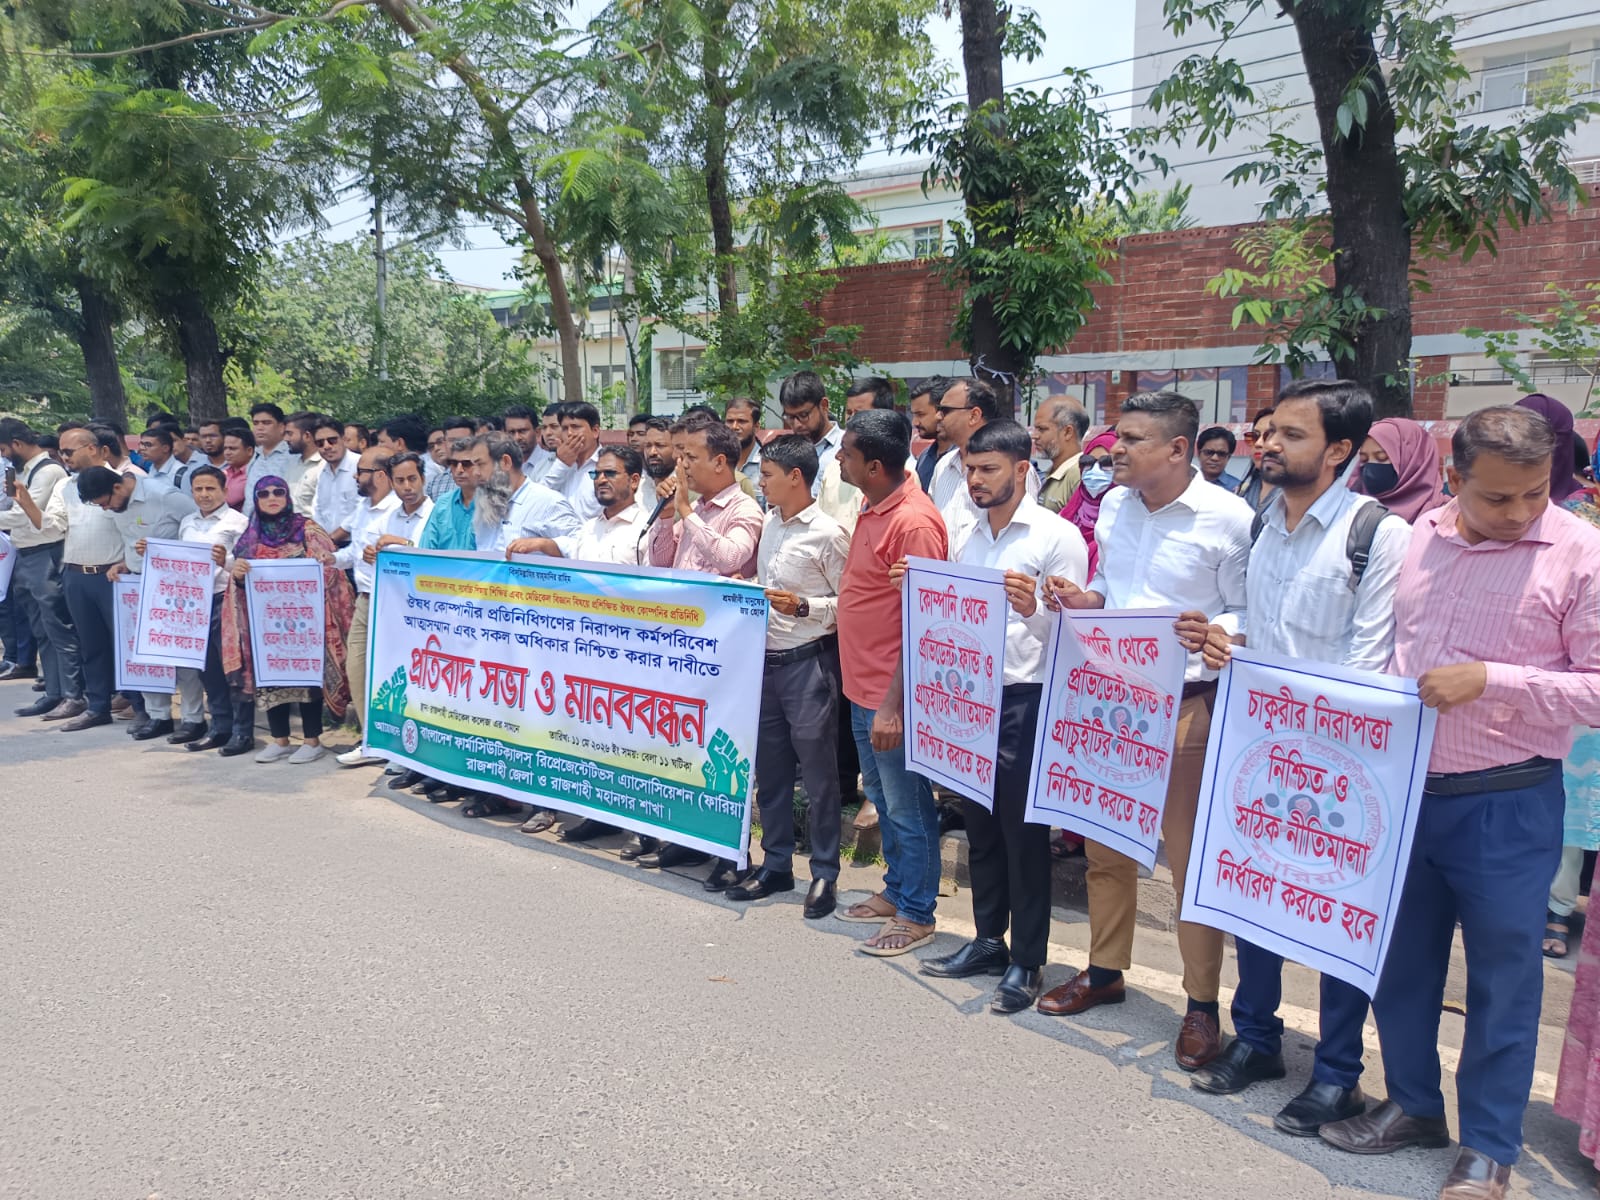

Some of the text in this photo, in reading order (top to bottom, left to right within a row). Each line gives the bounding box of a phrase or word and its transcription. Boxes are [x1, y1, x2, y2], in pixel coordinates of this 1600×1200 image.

[406, 593, 719, 655] ঔষধ কোম্পানীর প্রতিনিধিগণের নিরাপদ কর্মপরিবেশ
[509, 590, 523, 600] এবং
[918, 584, 989, 627] কোম্পানি থেকে
[404, 615, 723, 677] আত্মসম্মান এবং সকল অধিকার নিশ্চিত করার দাবীতে
[918, 628, 957, 668] প্রভিডেন্ট
[958, 645, 982, 676] ফান্ড
[984, 654, 994, 680] ও
[1118, 635, 1160, 667] থেকে
[409, 633, 708, 748] প্রতিবাদ সভা ও মানববন্ধন
[915, 680, 951, 721] গ্রাচুইটির
[952, 686, 996, 736] নীতিমালা
[1067, 660, 1127, 704] প্রভিডেন্ট
[1128, 684, 1163, 716] ফান্ড
[1163, 694, 1175, 720] ও
[1248, 685, 1393, 753] চাকুরীর নিরাপত্তা
[419, 726, 452, 747] বাংলাদেশ
[471, 715, 492, 727] কলেজ
[1051, 718, 1113, 761] গ্রাচুইটির
[1115, 726, 1169, 783] নীতিমালা
[571, 735, 580, 746] ১১
[581, 738, 590, 748] মে
[641, 752, 658, 765] বেলা
[659, 755, 669, 766] ১১
[670, 757, 693, 772] ঘটিকা
[916, 722, 944, 763] নিশ্চিত
[946, 741, 973, 774] করতে
[975, 753, 994, 785] হবে
[1267, 744, 1328, 794] নিশ্চিত
[1333, 774, 1349, 803] ও
[465, 757, 507, 780] রাজশাহী
[508, 769, 534, 786] জেলা
[537, 775, 547, 787] ও
[550, 776, 593, 801] রাজশাহী
[595, 787, 637, 811] মহানগর
[1046, 762, 1160, 838] নিশ্চিত করতে হবে
[1235, 797, 1282, 844] সঠিক
[1286, 809, 1372, 878] নীতিমালা
[1216, 849, 1379, 946] নির্ধারণ করতে হবে
